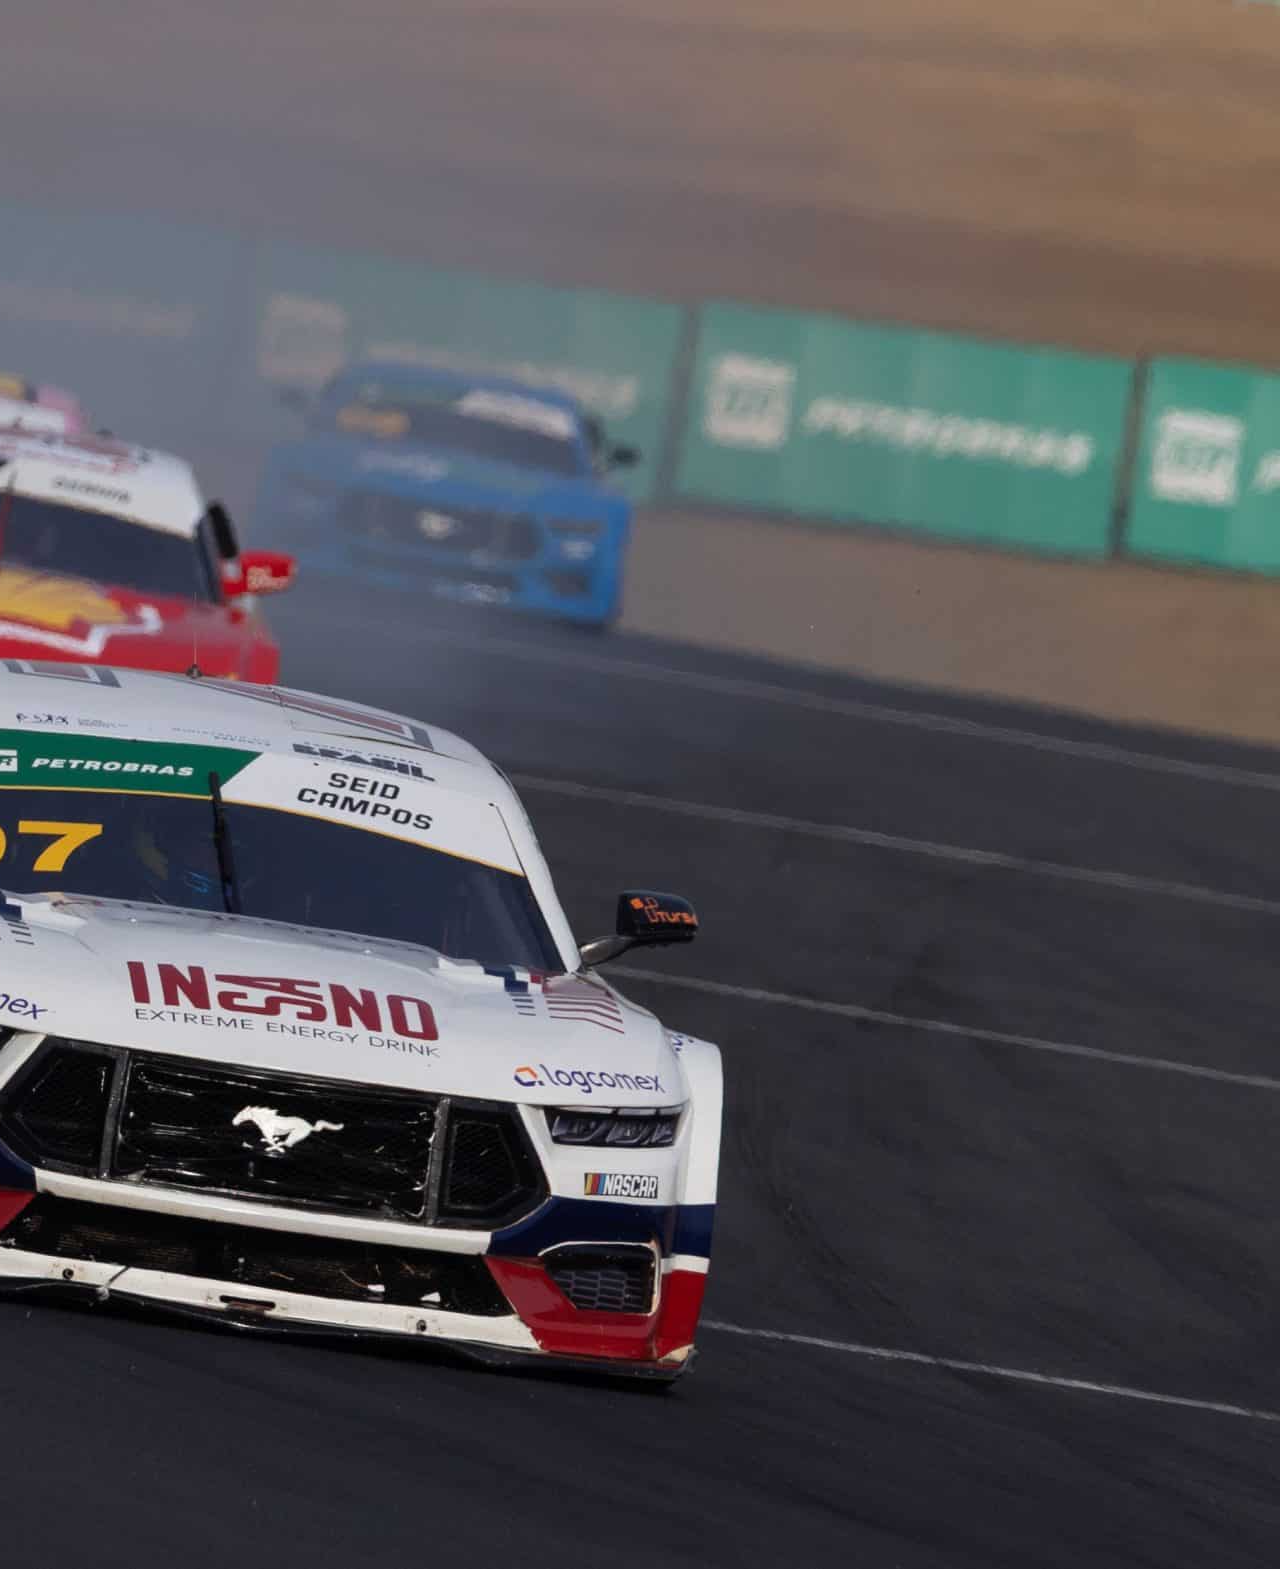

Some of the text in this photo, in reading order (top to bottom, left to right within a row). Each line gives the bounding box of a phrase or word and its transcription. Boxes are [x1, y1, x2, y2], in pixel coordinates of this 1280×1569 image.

[31, 756, 195, 777] PETROBRAS
[327, 772, 400, 800] SEID
[297, 787, 433, 830] CAMPOS
[135, 1007, 440, 1058] EXTREME ENERGY DRINK
[539, 1064, 665, 1094] logcomex
[604, 1173, 658, 1198] NASCAR
